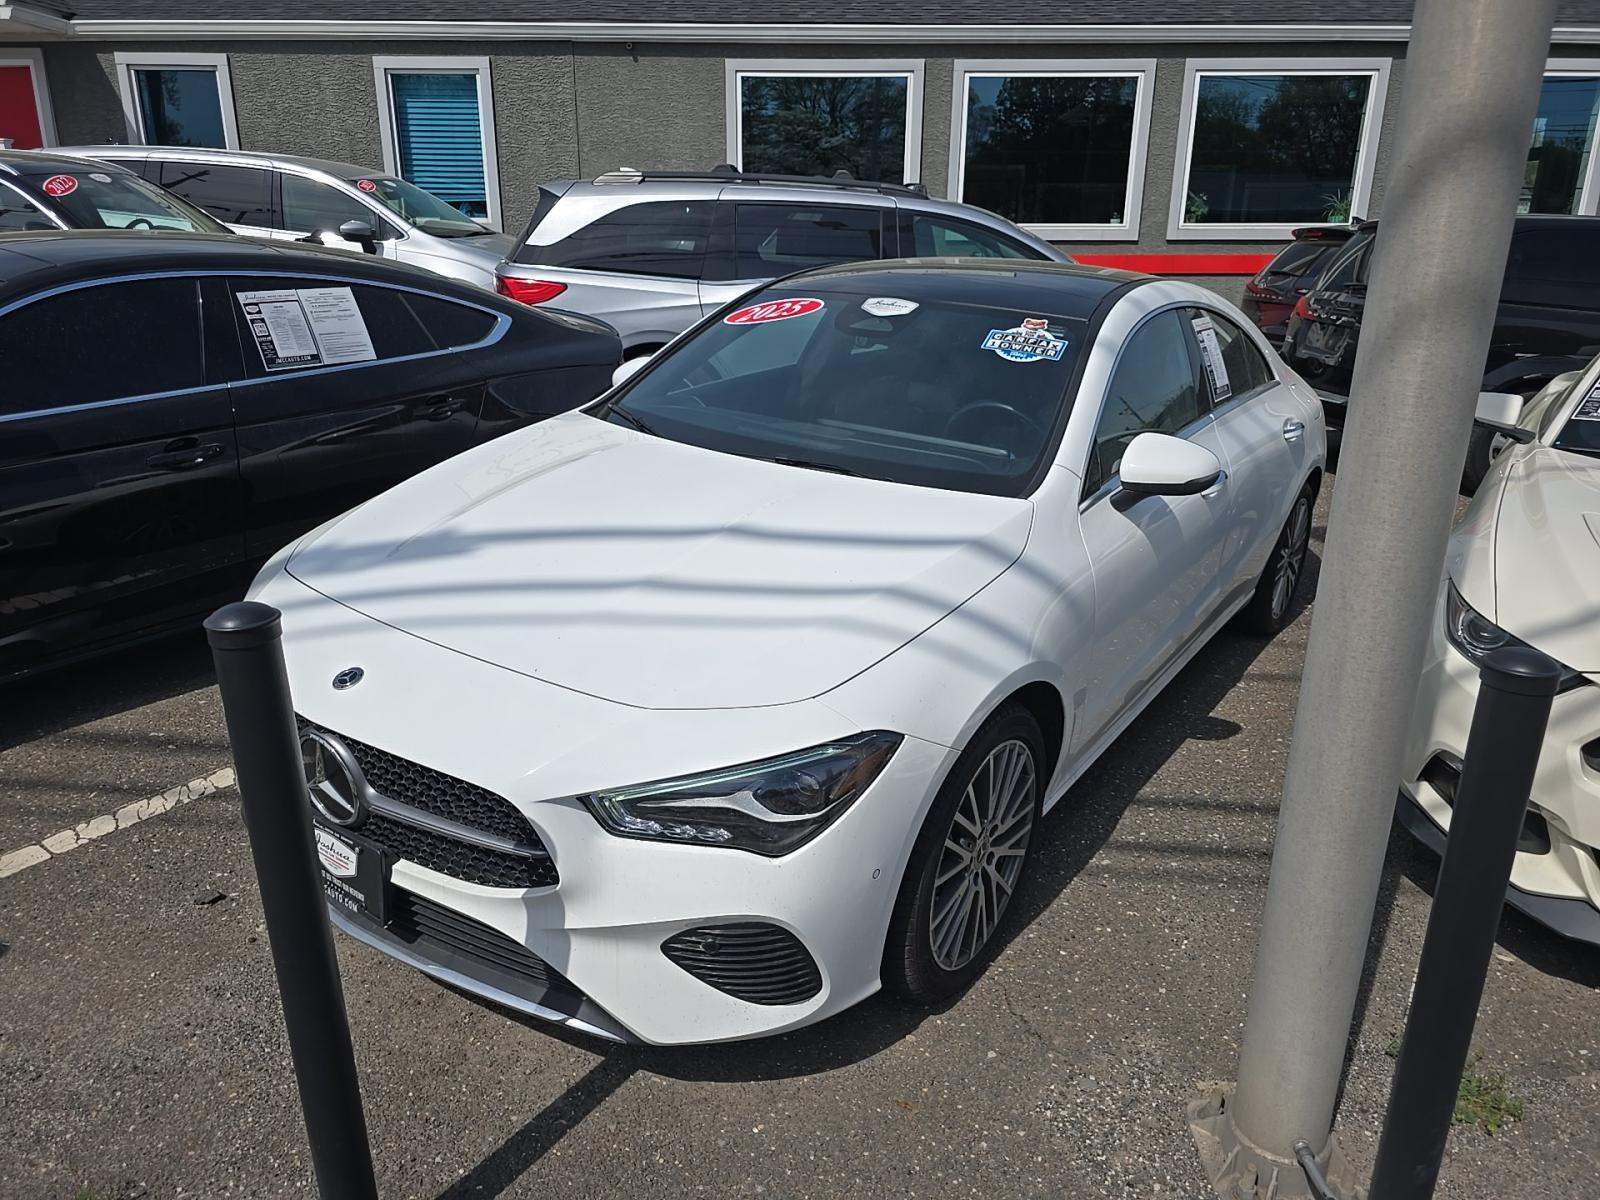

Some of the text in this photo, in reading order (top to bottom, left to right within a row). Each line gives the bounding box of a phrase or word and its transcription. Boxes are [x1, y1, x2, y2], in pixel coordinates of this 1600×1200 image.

[48, 177, 73, 194] 2022
[735, 300, 811, 322] 2025
[993, 333, 1060, 350] CARFAX
[1000, 342, 1057, 357] OWNER
[316, 832, 351, 861] Joshua
